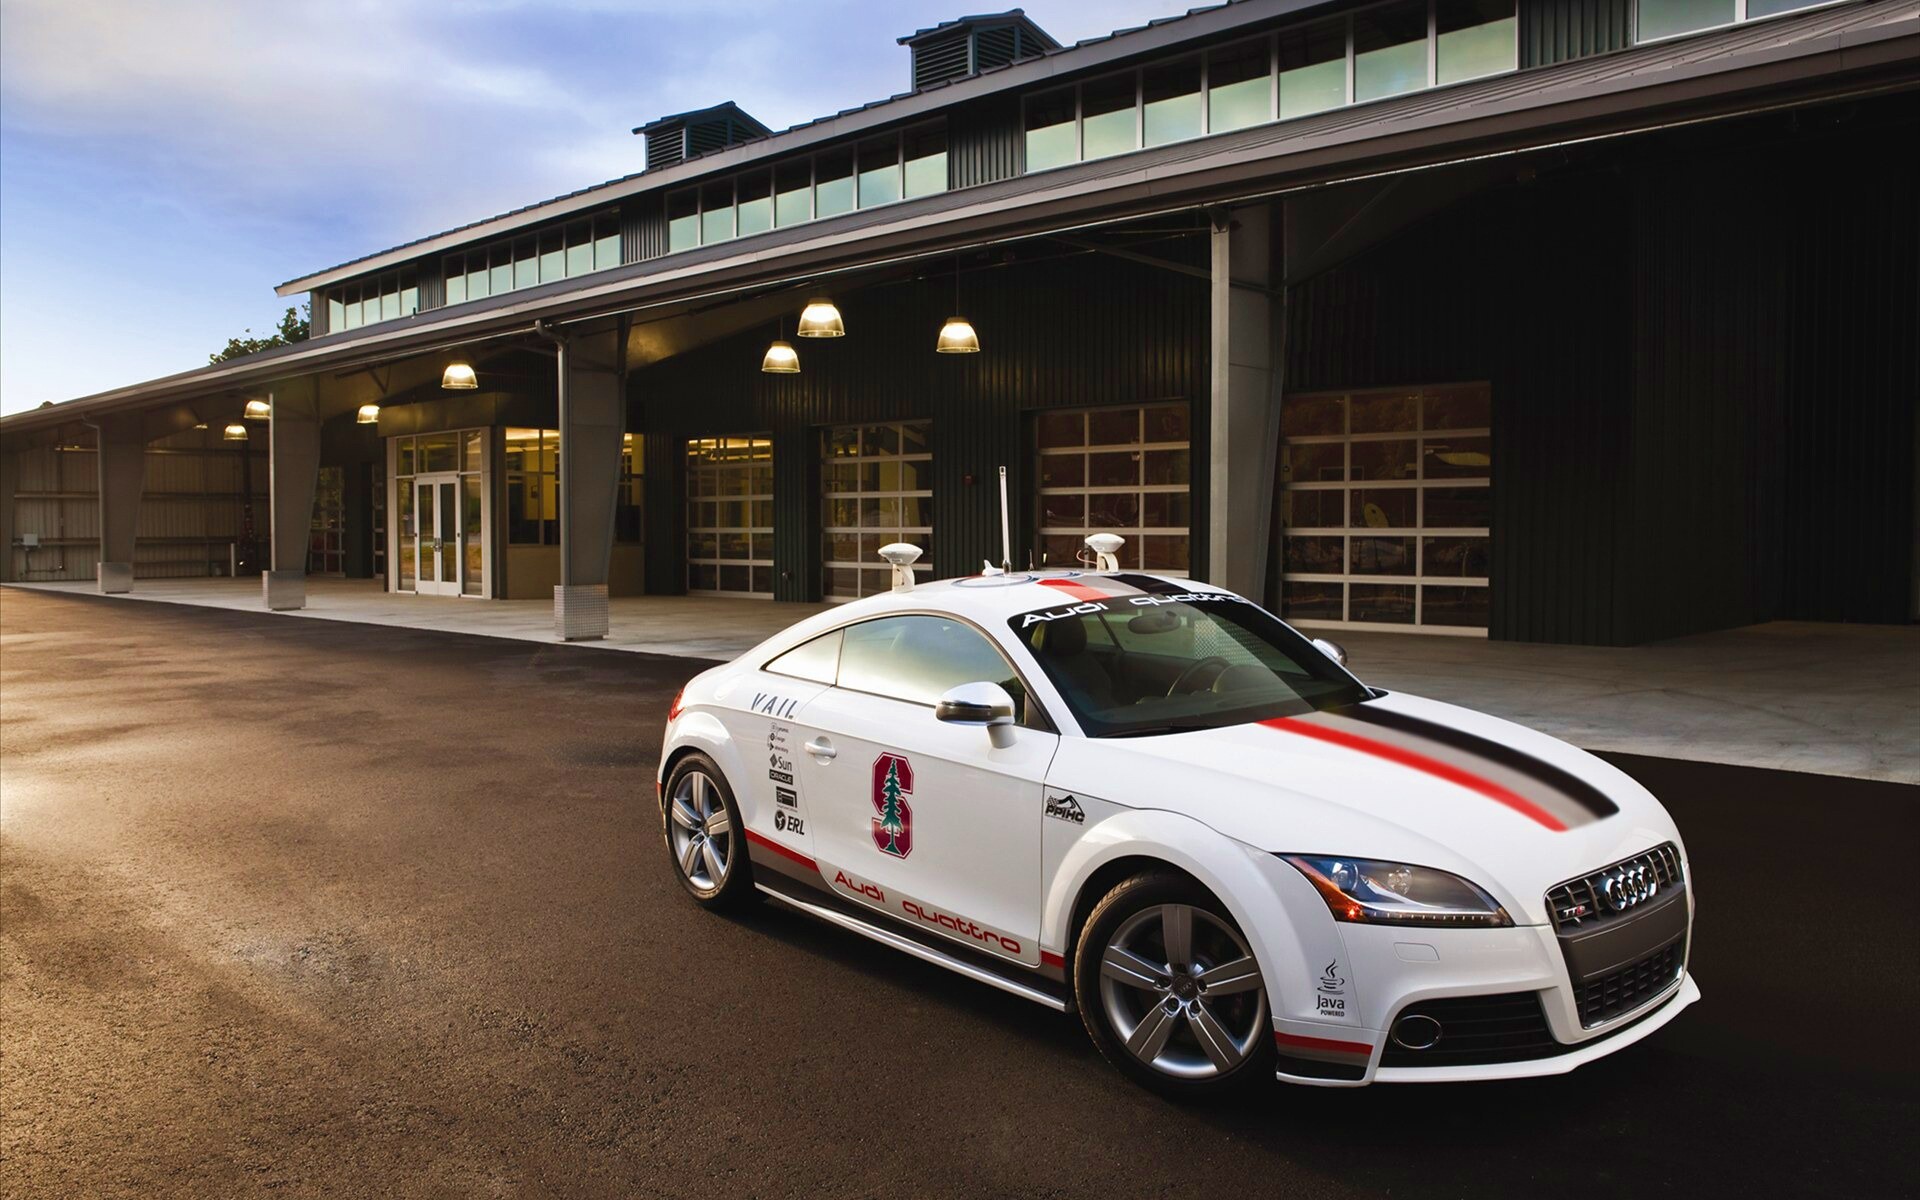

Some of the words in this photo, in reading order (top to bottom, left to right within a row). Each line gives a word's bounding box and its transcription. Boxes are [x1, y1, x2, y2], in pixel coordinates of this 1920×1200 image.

[1022, 603, 1109, 628] Audi
[1128, 592, 1250, 606] quattro
[751, 692, 797, 719] VAIL
[778, 756, 792, 771] Sun
[770, 771, 792, 783] ORACLE
[1045, 804, 1085, 822] PPIHC
[787, 816, 805, 835] ERL
[835, 871, 886, 903] Audi
[902, 900, 1021, 954] quattro
[1316, 994, 1345, 1010] Java
